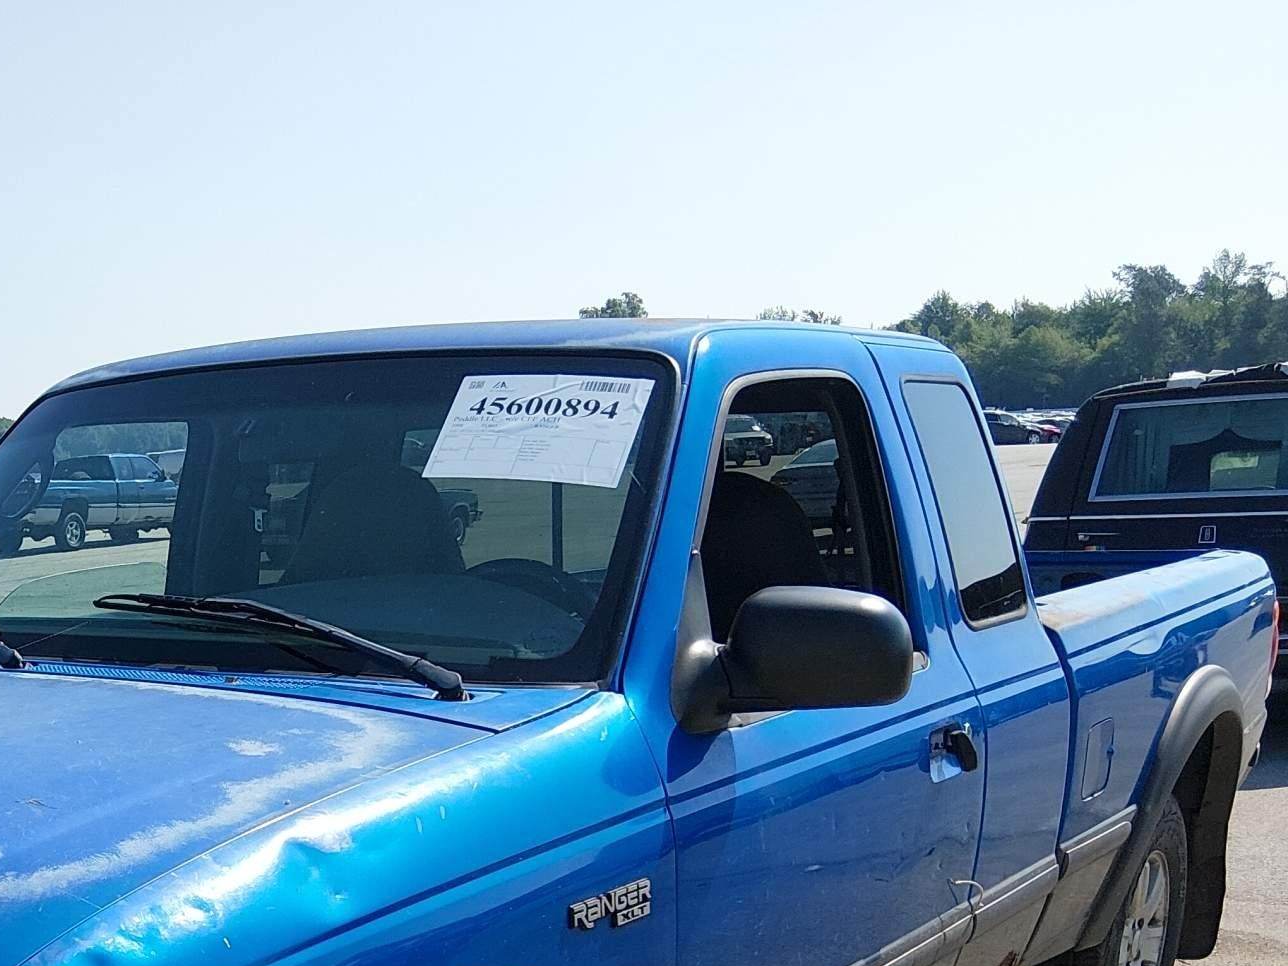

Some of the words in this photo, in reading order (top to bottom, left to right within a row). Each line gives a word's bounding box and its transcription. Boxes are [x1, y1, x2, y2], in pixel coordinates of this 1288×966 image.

[469, 396, 619, 419] 45600894
[570, 878, 651, 928] RANGER
[620, 903, 649, 922] XLT
